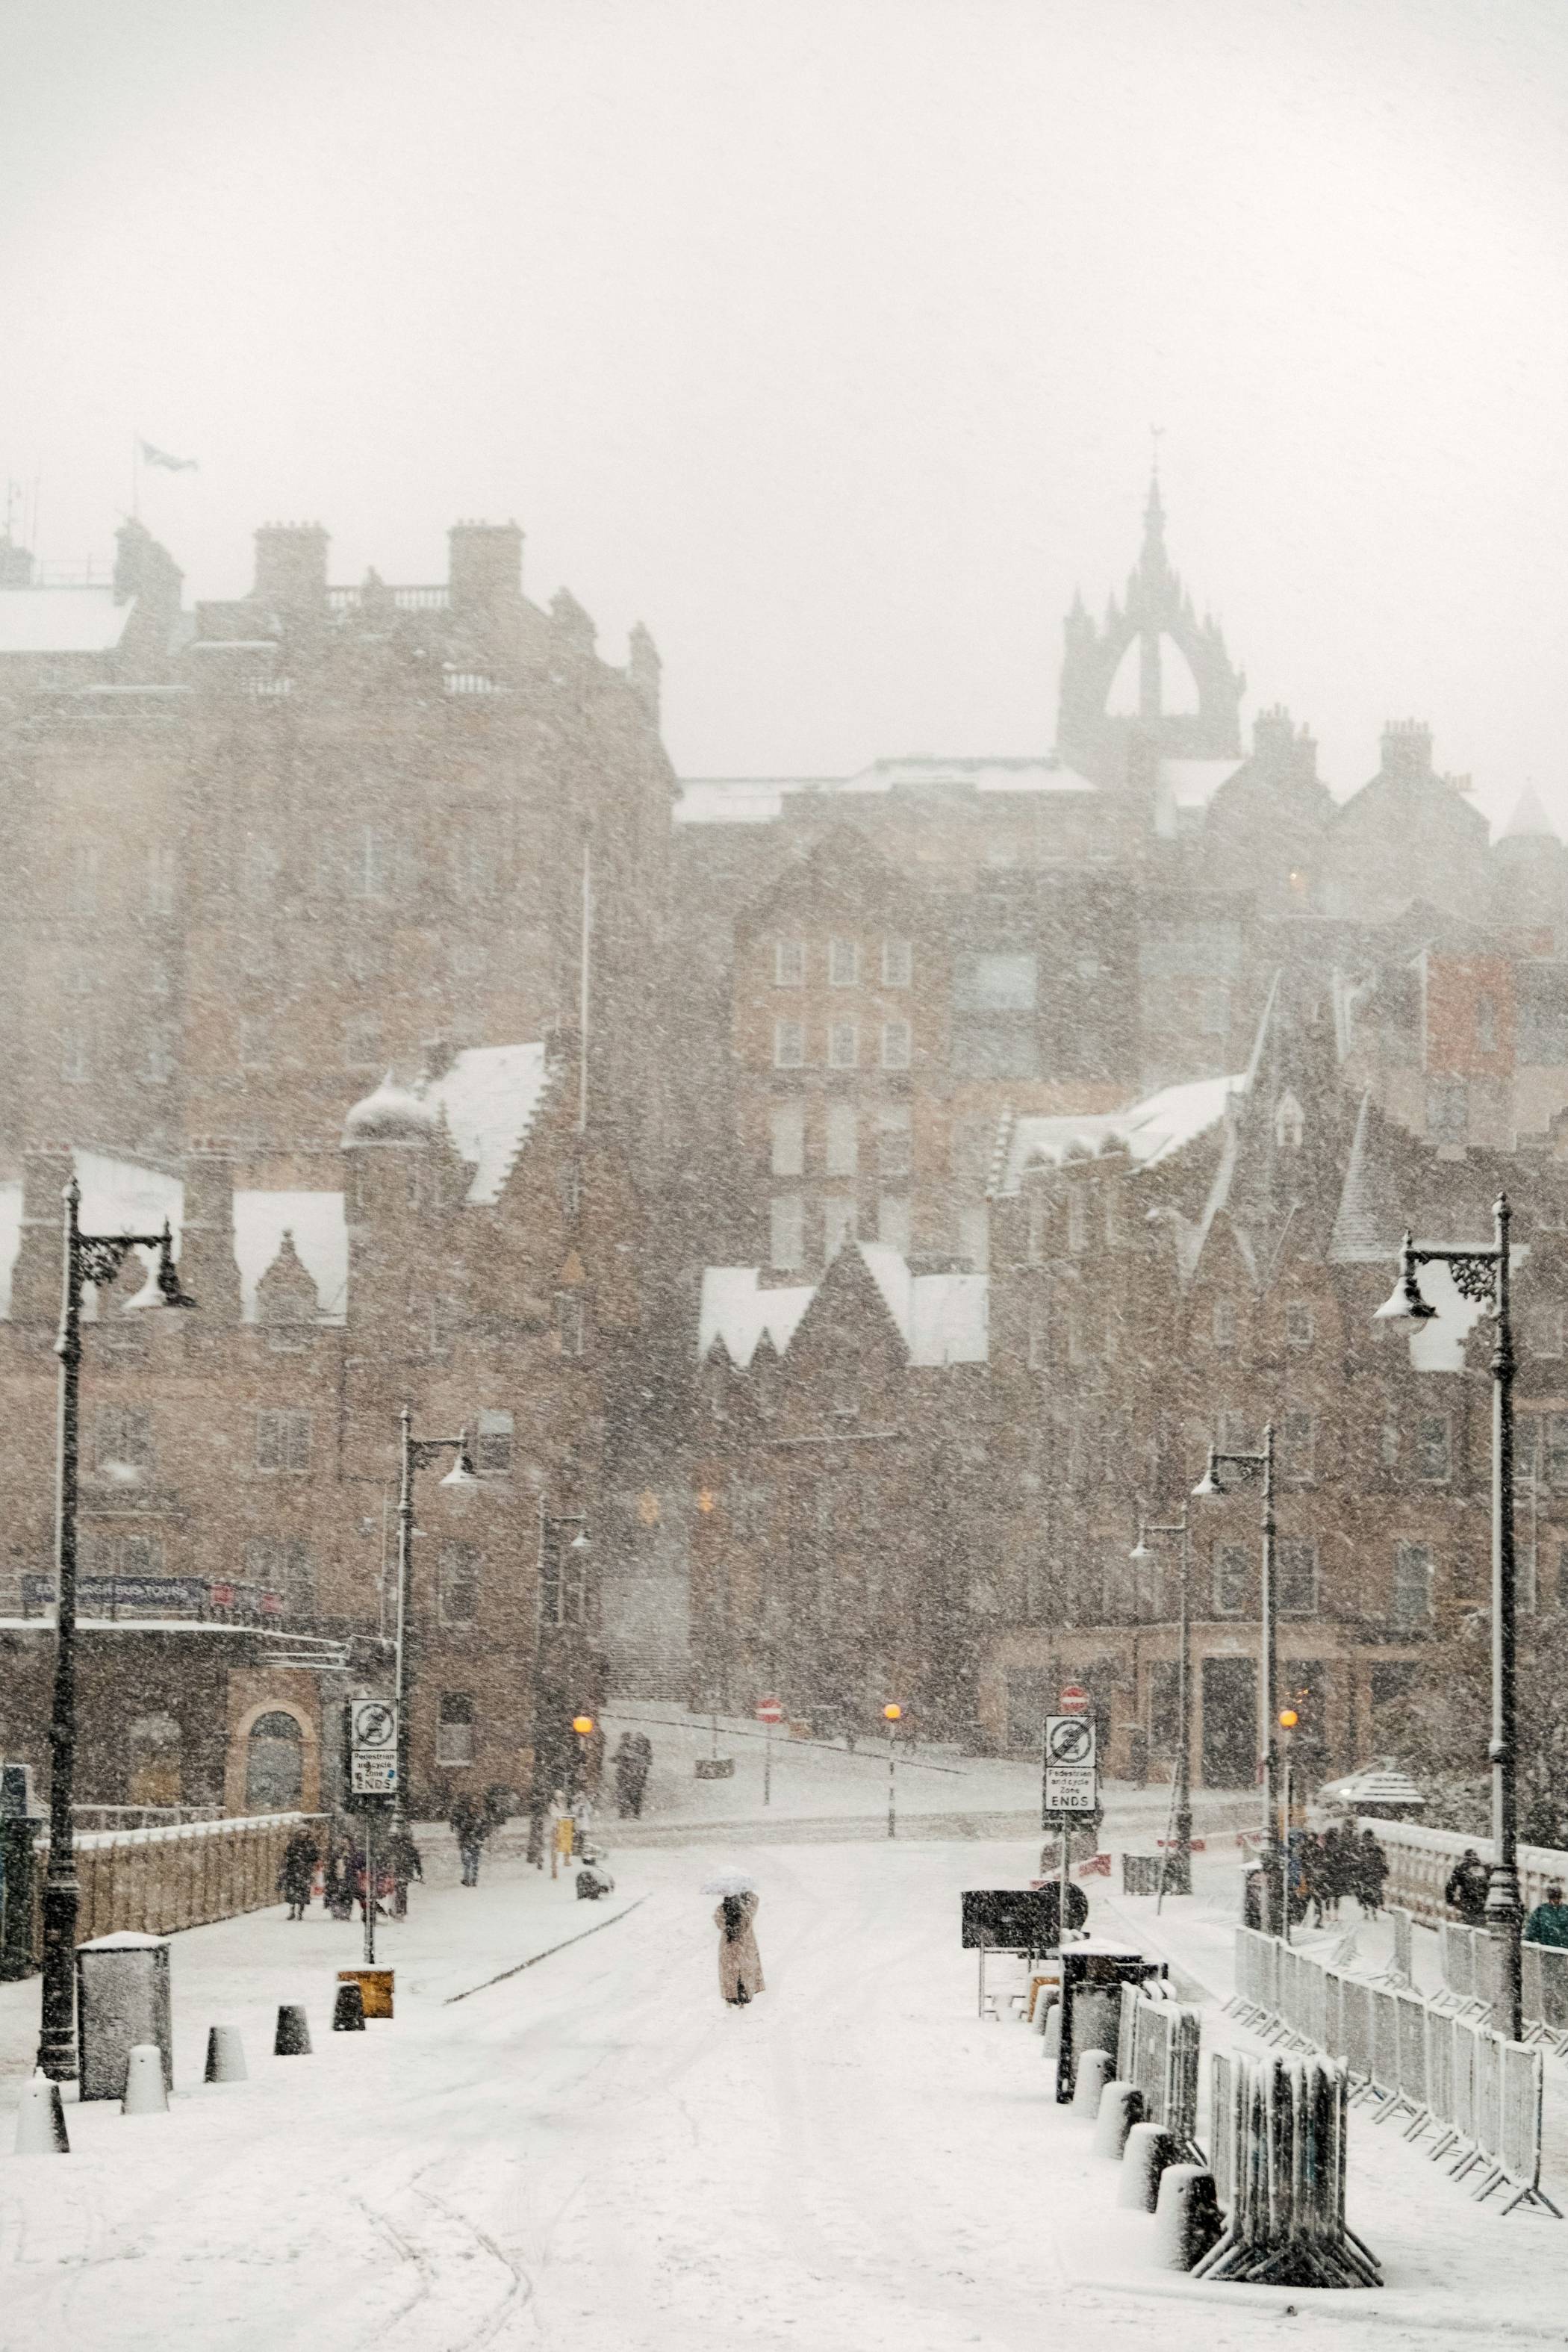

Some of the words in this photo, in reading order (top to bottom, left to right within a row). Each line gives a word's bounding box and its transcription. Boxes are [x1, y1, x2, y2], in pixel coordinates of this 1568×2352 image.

[36, 1583, 112, 1596] EDURGH
[114, 1584, 143, 1596] BUS
[145, 1584, 188, 1598] TOURS
[357, 1779, 391, 1789] ENDS
[1051, 1796, 1089, 1806] ENDS
